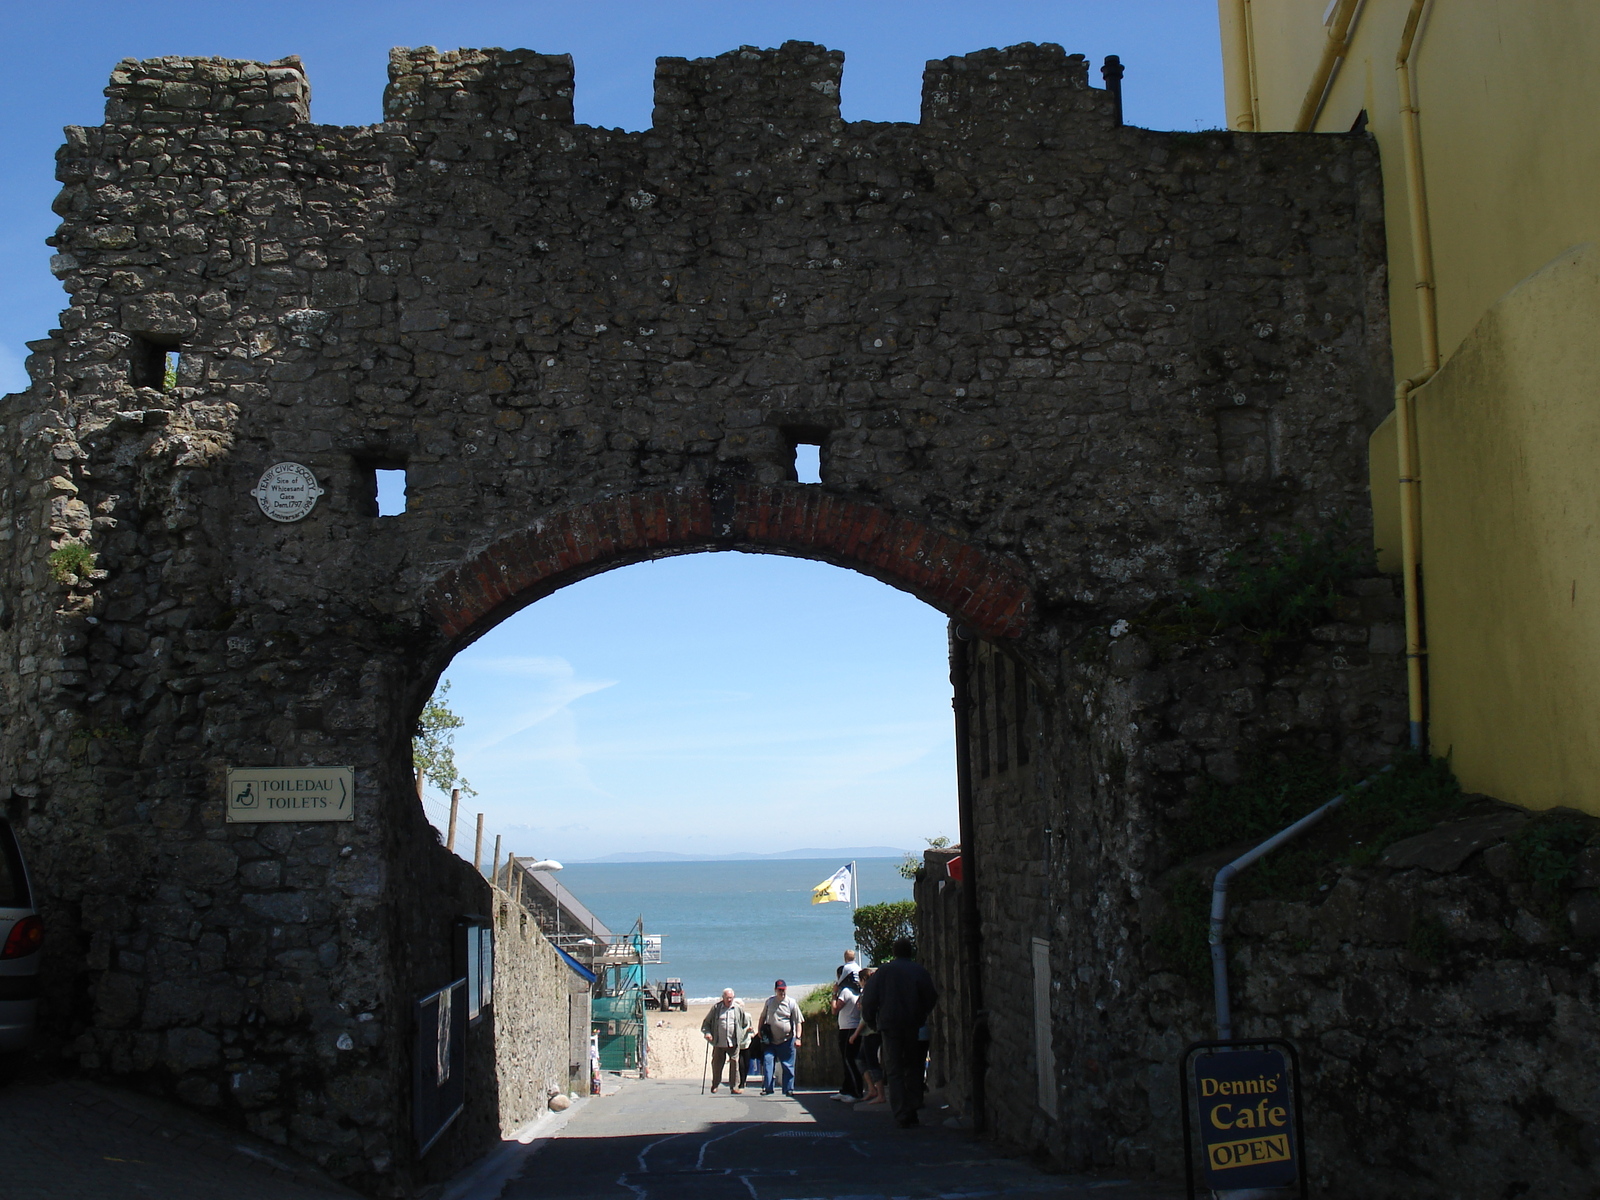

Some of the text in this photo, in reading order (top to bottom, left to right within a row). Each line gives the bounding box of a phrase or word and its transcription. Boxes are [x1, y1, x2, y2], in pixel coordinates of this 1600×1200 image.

[260, 465, 316, 491] TENBY CIVIC SOCIETY
[269, 510, 305, 520] Anniversary
[261, 780, 333, 792] TOILEDAU
[267, 797, 327, 809] TOILETS
[1201, 1073, 1281, 1097] Dennis'
[1210, 1098, 1287, 1130] Cafe
[1213, 1138, 1286, 1166] OPEN
